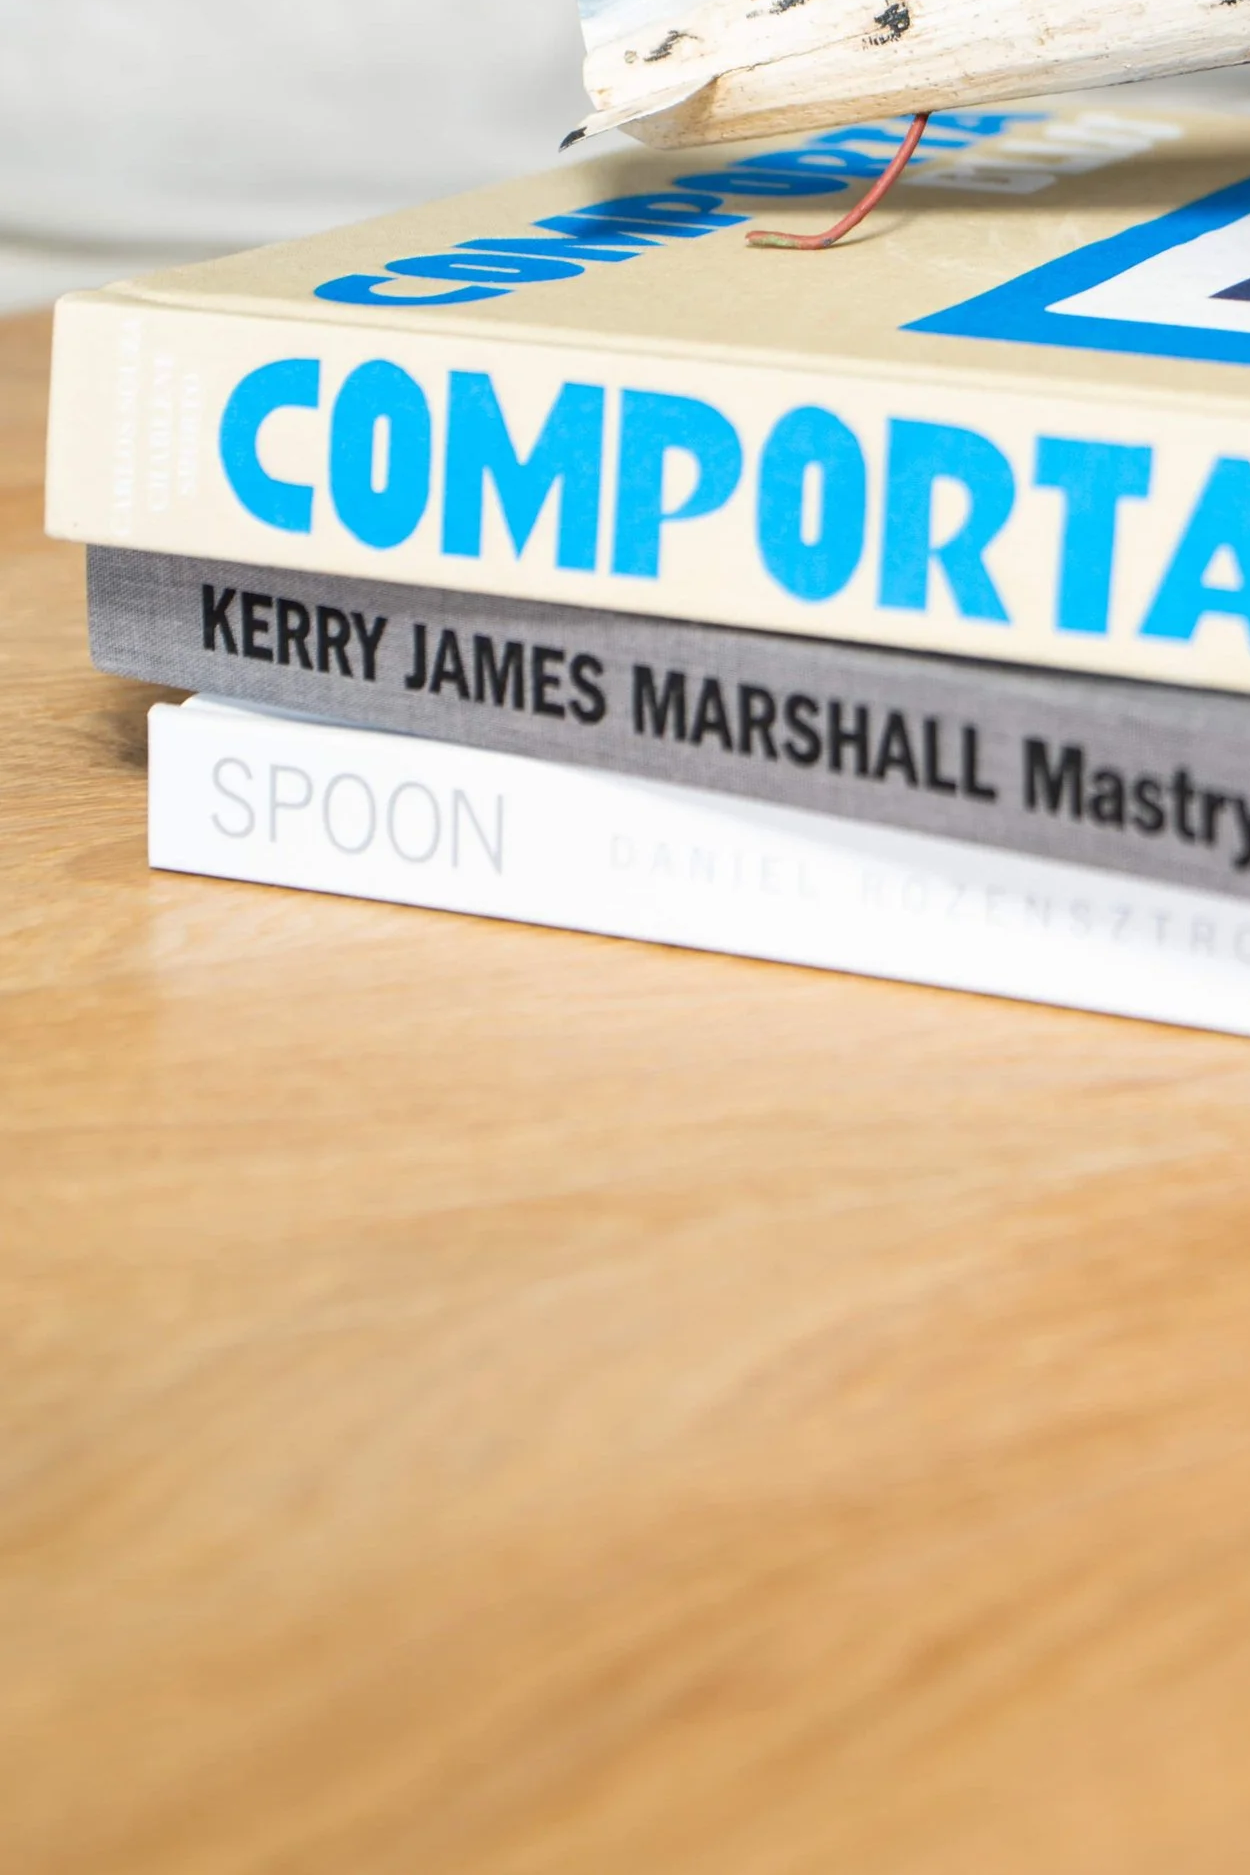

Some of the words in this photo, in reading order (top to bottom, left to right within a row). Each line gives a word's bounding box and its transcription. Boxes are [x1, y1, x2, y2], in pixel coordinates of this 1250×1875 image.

[313, 111, 1052, 308] COMPORTA
[200, 582, 389, 682] KERRY
[404, 623, 607, 724] JAMES
[633, 664, 997, 801] MARSHALL
[209, 755, 506, 877] SPOON
[608, 832, 820, 902] DANIEL
